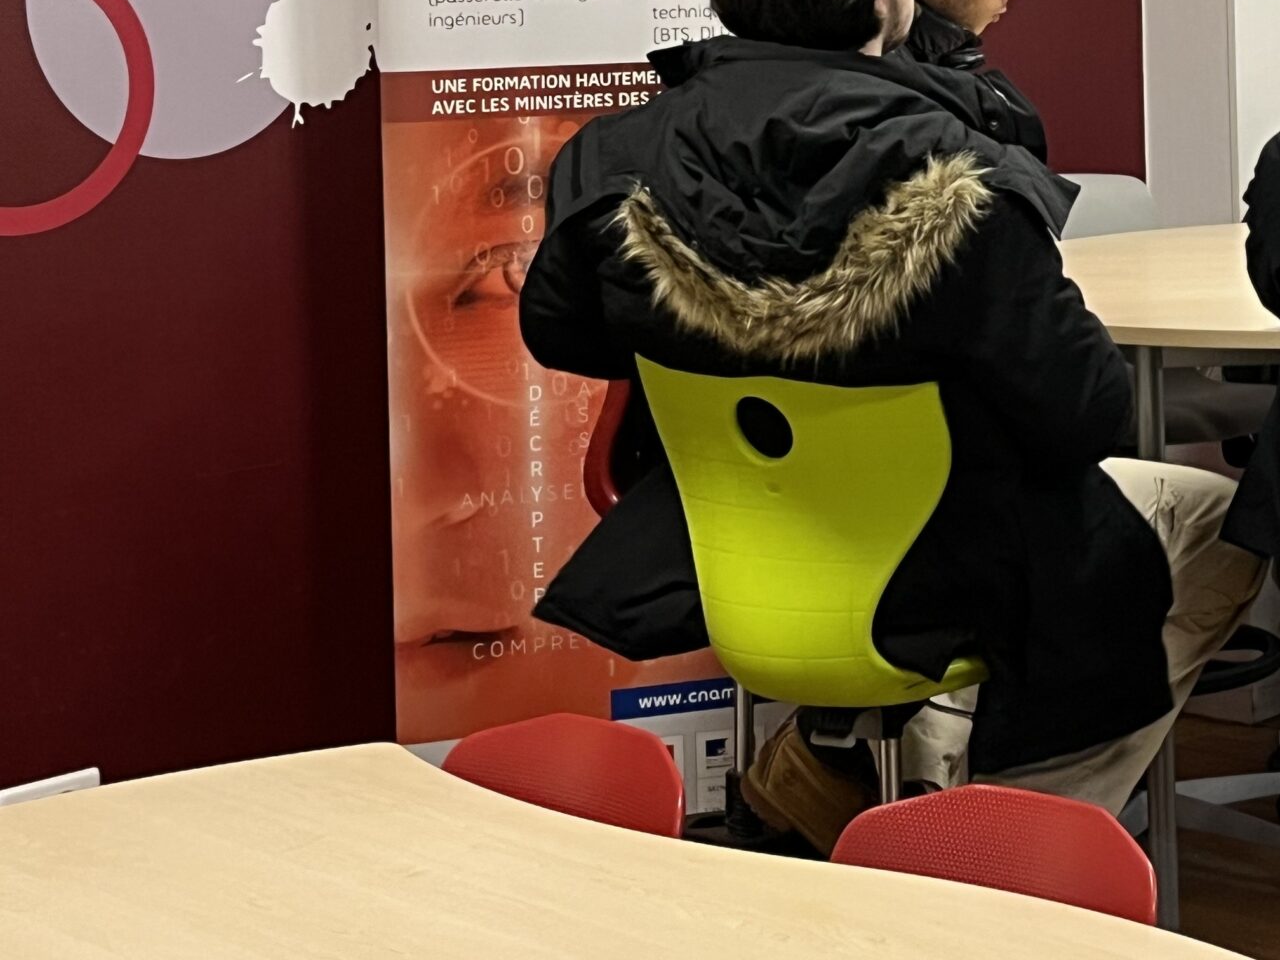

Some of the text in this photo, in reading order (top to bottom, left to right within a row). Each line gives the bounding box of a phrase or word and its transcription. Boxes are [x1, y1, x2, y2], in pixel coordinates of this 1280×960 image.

[431, 78, 467, 94] UNE
[472, 74, 571, 92] FORMATION
[431, 99, 476, 115] AVEC
[481, 97, 510, 113] LES
[515, 91, 613, 111] MINISTÈRES
[618, 91, 650, 107] DES
